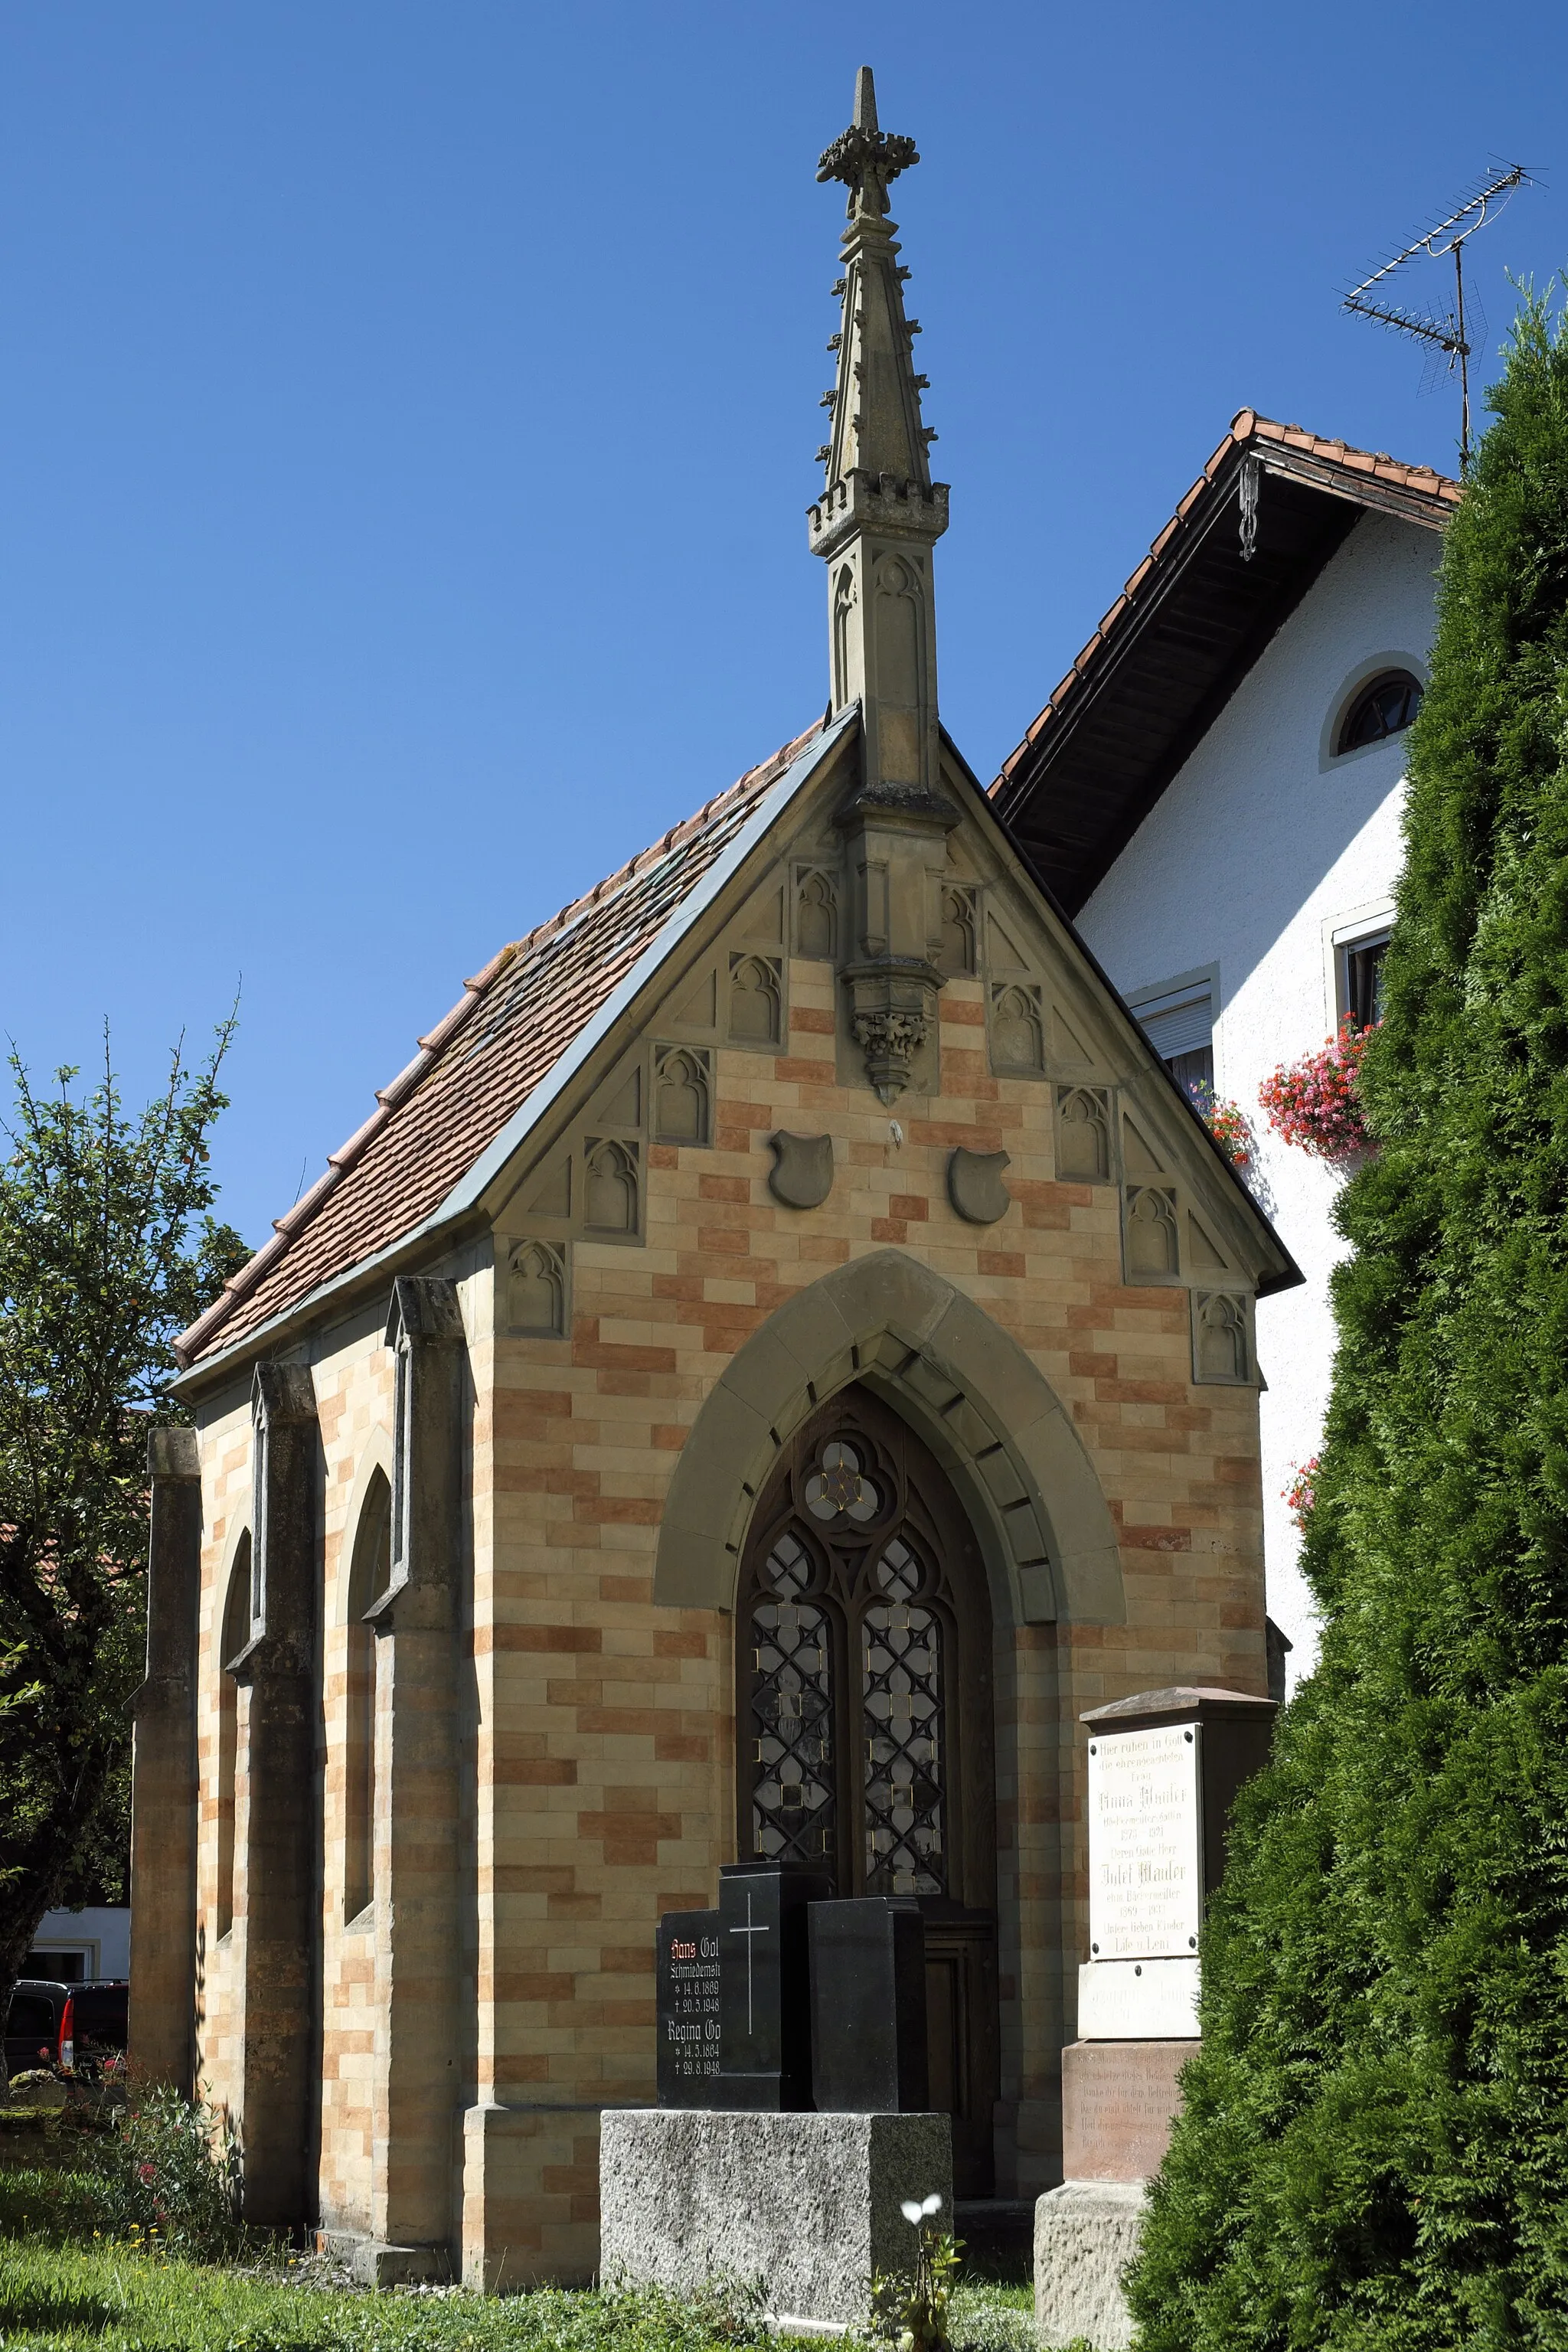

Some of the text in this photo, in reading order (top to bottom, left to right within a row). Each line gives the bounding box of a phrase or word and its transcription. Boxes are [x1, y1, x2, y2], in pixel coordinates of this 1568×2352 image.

[1099, 1733, 1183, 1757] Hier ruhen in Gott
[1099, 1760, 1112, 1771] die
[1158, 1842, 1177, 1856] Herr
[1131, 1919, 1153, 1933] lieben
[1156, 1918, 1184, 1931] Kinder
[670, 1939, 696, 1961] Hans
[668, 2020, 701, 2043] Regina
